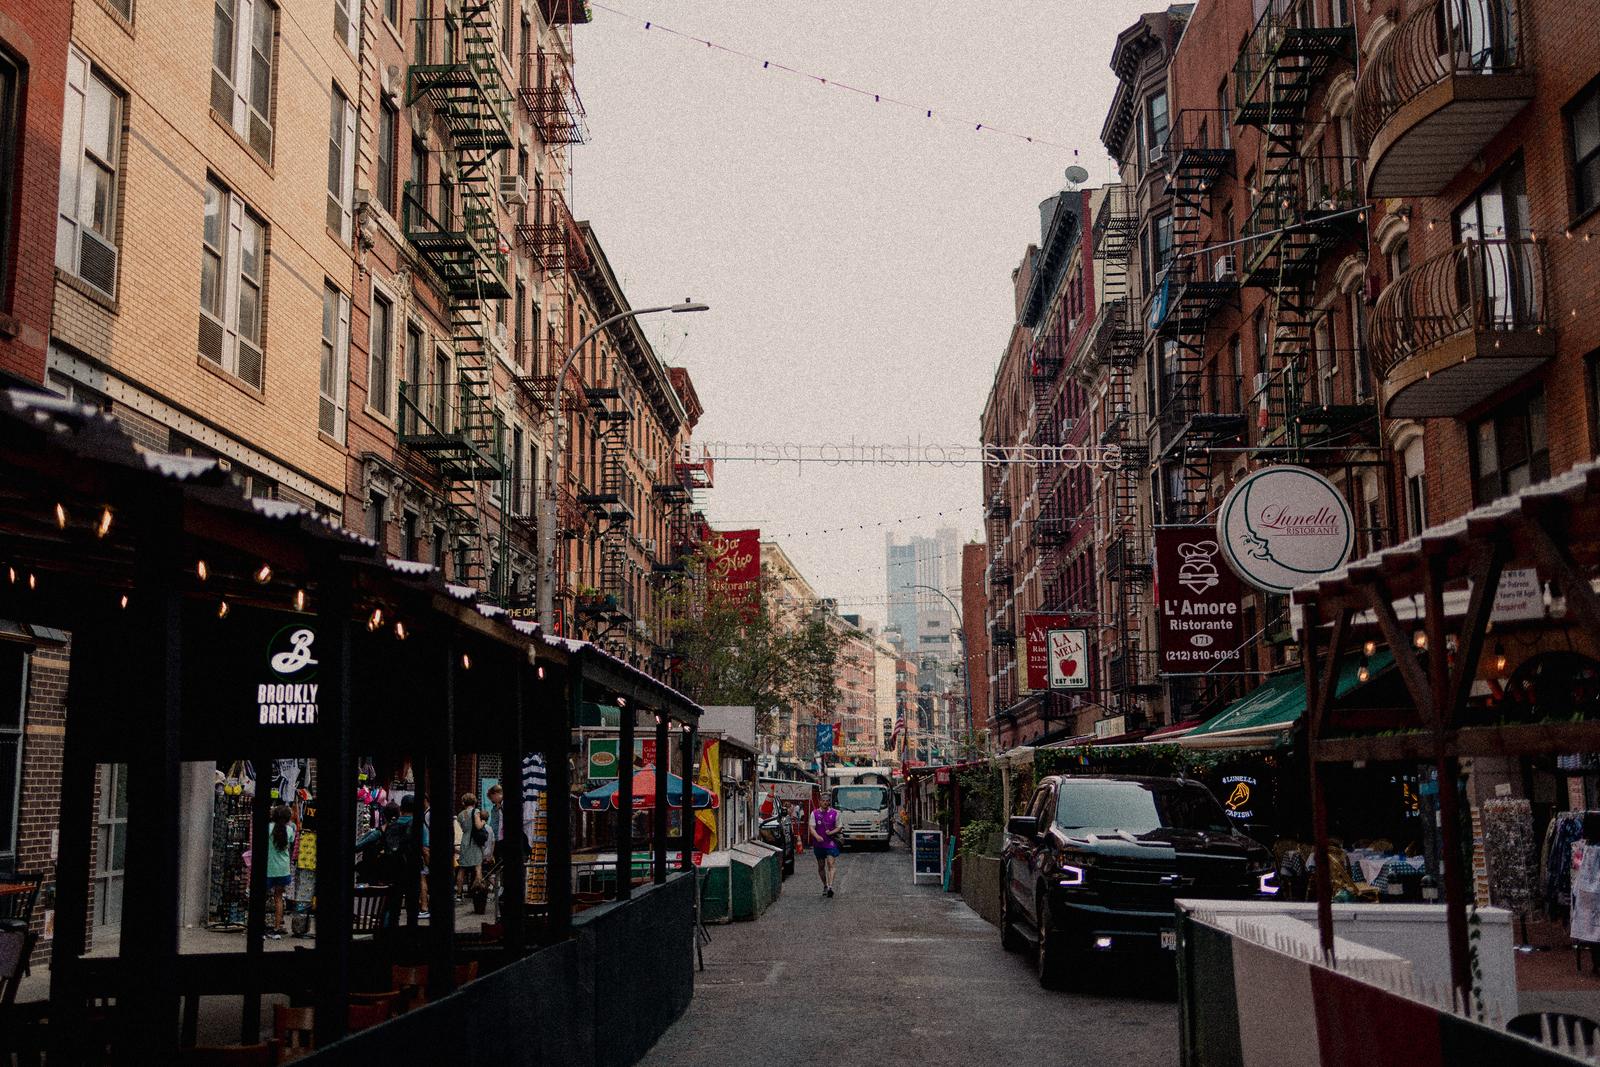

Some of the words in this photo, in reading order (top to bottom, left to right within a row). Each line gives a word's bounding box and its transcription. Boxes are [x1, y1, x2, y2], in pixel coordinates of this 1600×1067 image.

[1258, 503, 1337, 529] Lunella
[1286, 527, 1340, 535] RISTORANTE
[716, 550, 753, 577] Nico
[1164, 599, 1237, 615] L'Amore
[1169, 619, 1233, 631] Ristorante
[1053, 633, 1071, 648] LA
[1195, 636, 1209, 645] 171
[1054, 642, 1082, 659] MELA
[1166, 650, 1191, 661] (212)
[257, 683, 319, 704] BROOKLY
